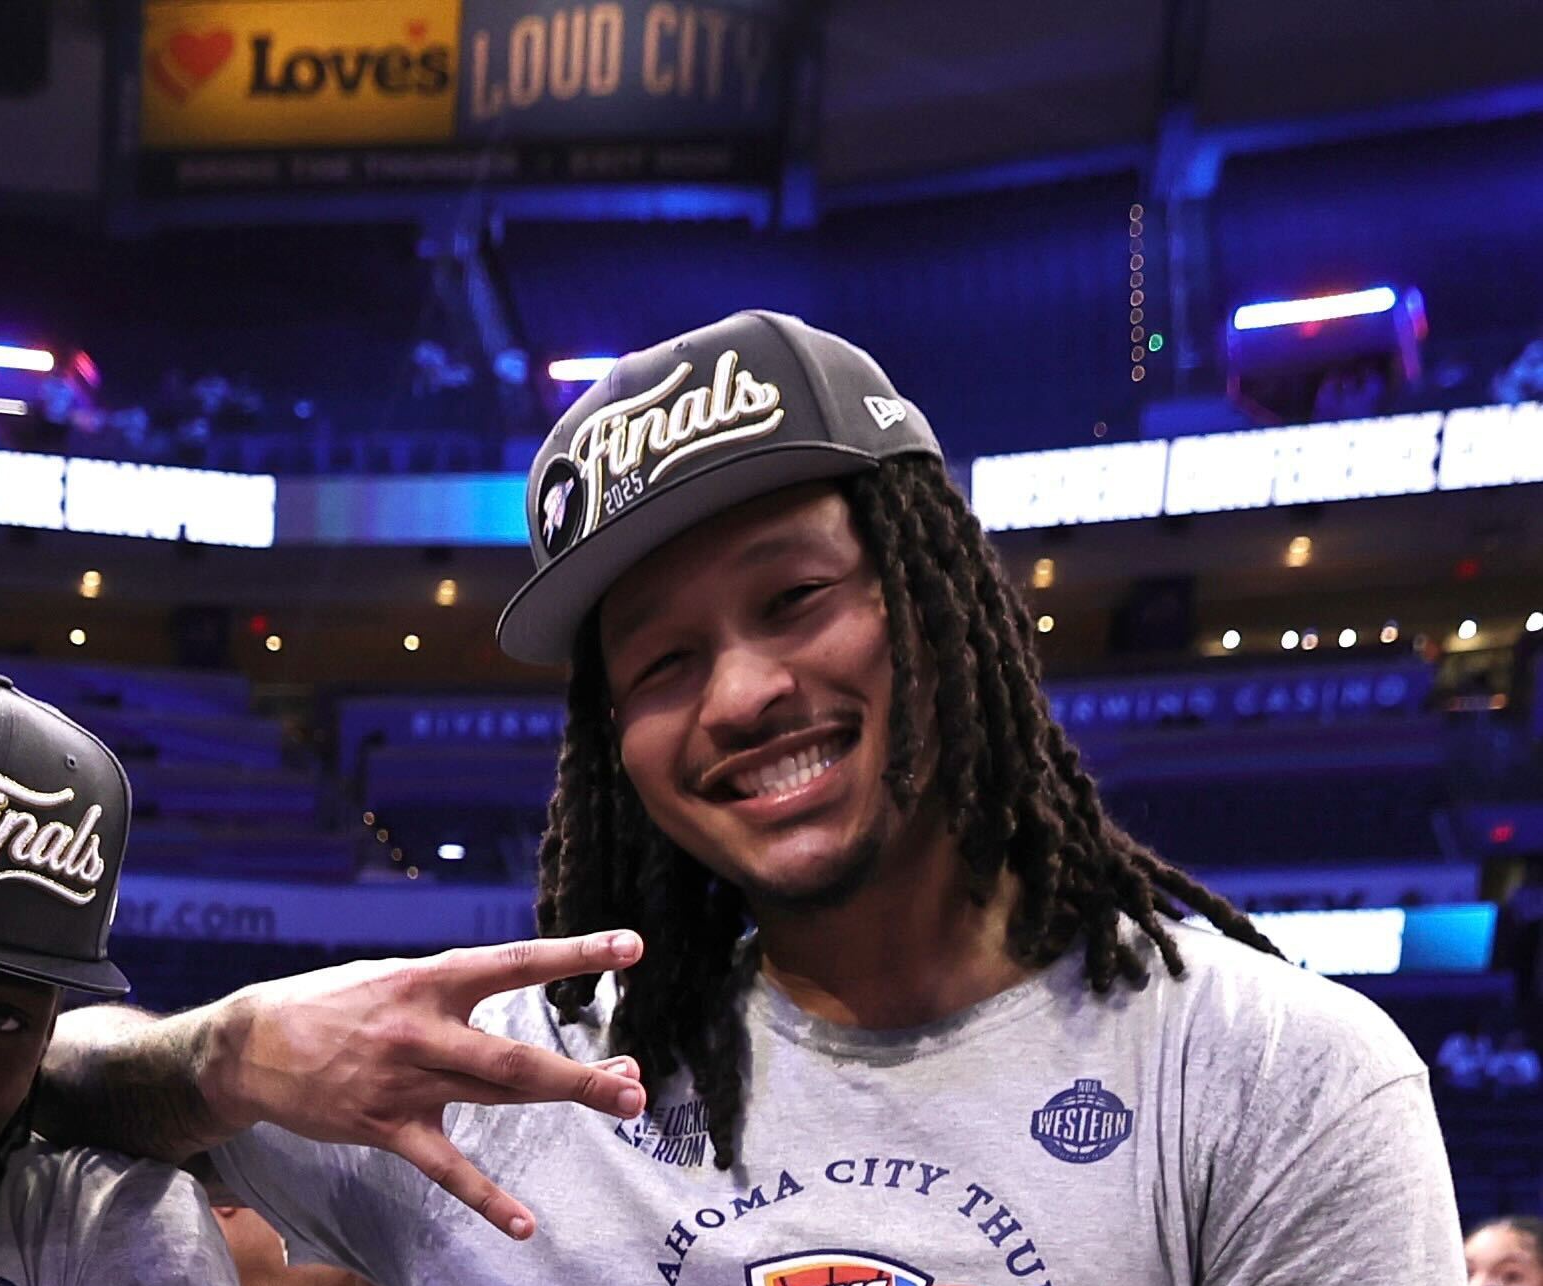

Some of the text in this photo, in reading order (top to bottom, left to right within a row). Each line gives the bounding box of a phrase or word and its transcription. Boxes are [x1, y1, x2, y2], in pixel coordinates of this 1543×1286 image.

[471, 3, 768, 121] LOUD CITY
[569, 350, 785, 539] Finals
[603, 470, 644, 515] 2025
[664, 1100, 709, 1137] LOCK
[1038, 1108, 1127, 1143] WESTERN
[652, 1134, 707, 1167] ROOM
[824, 1157, 950, 1197] CITY
